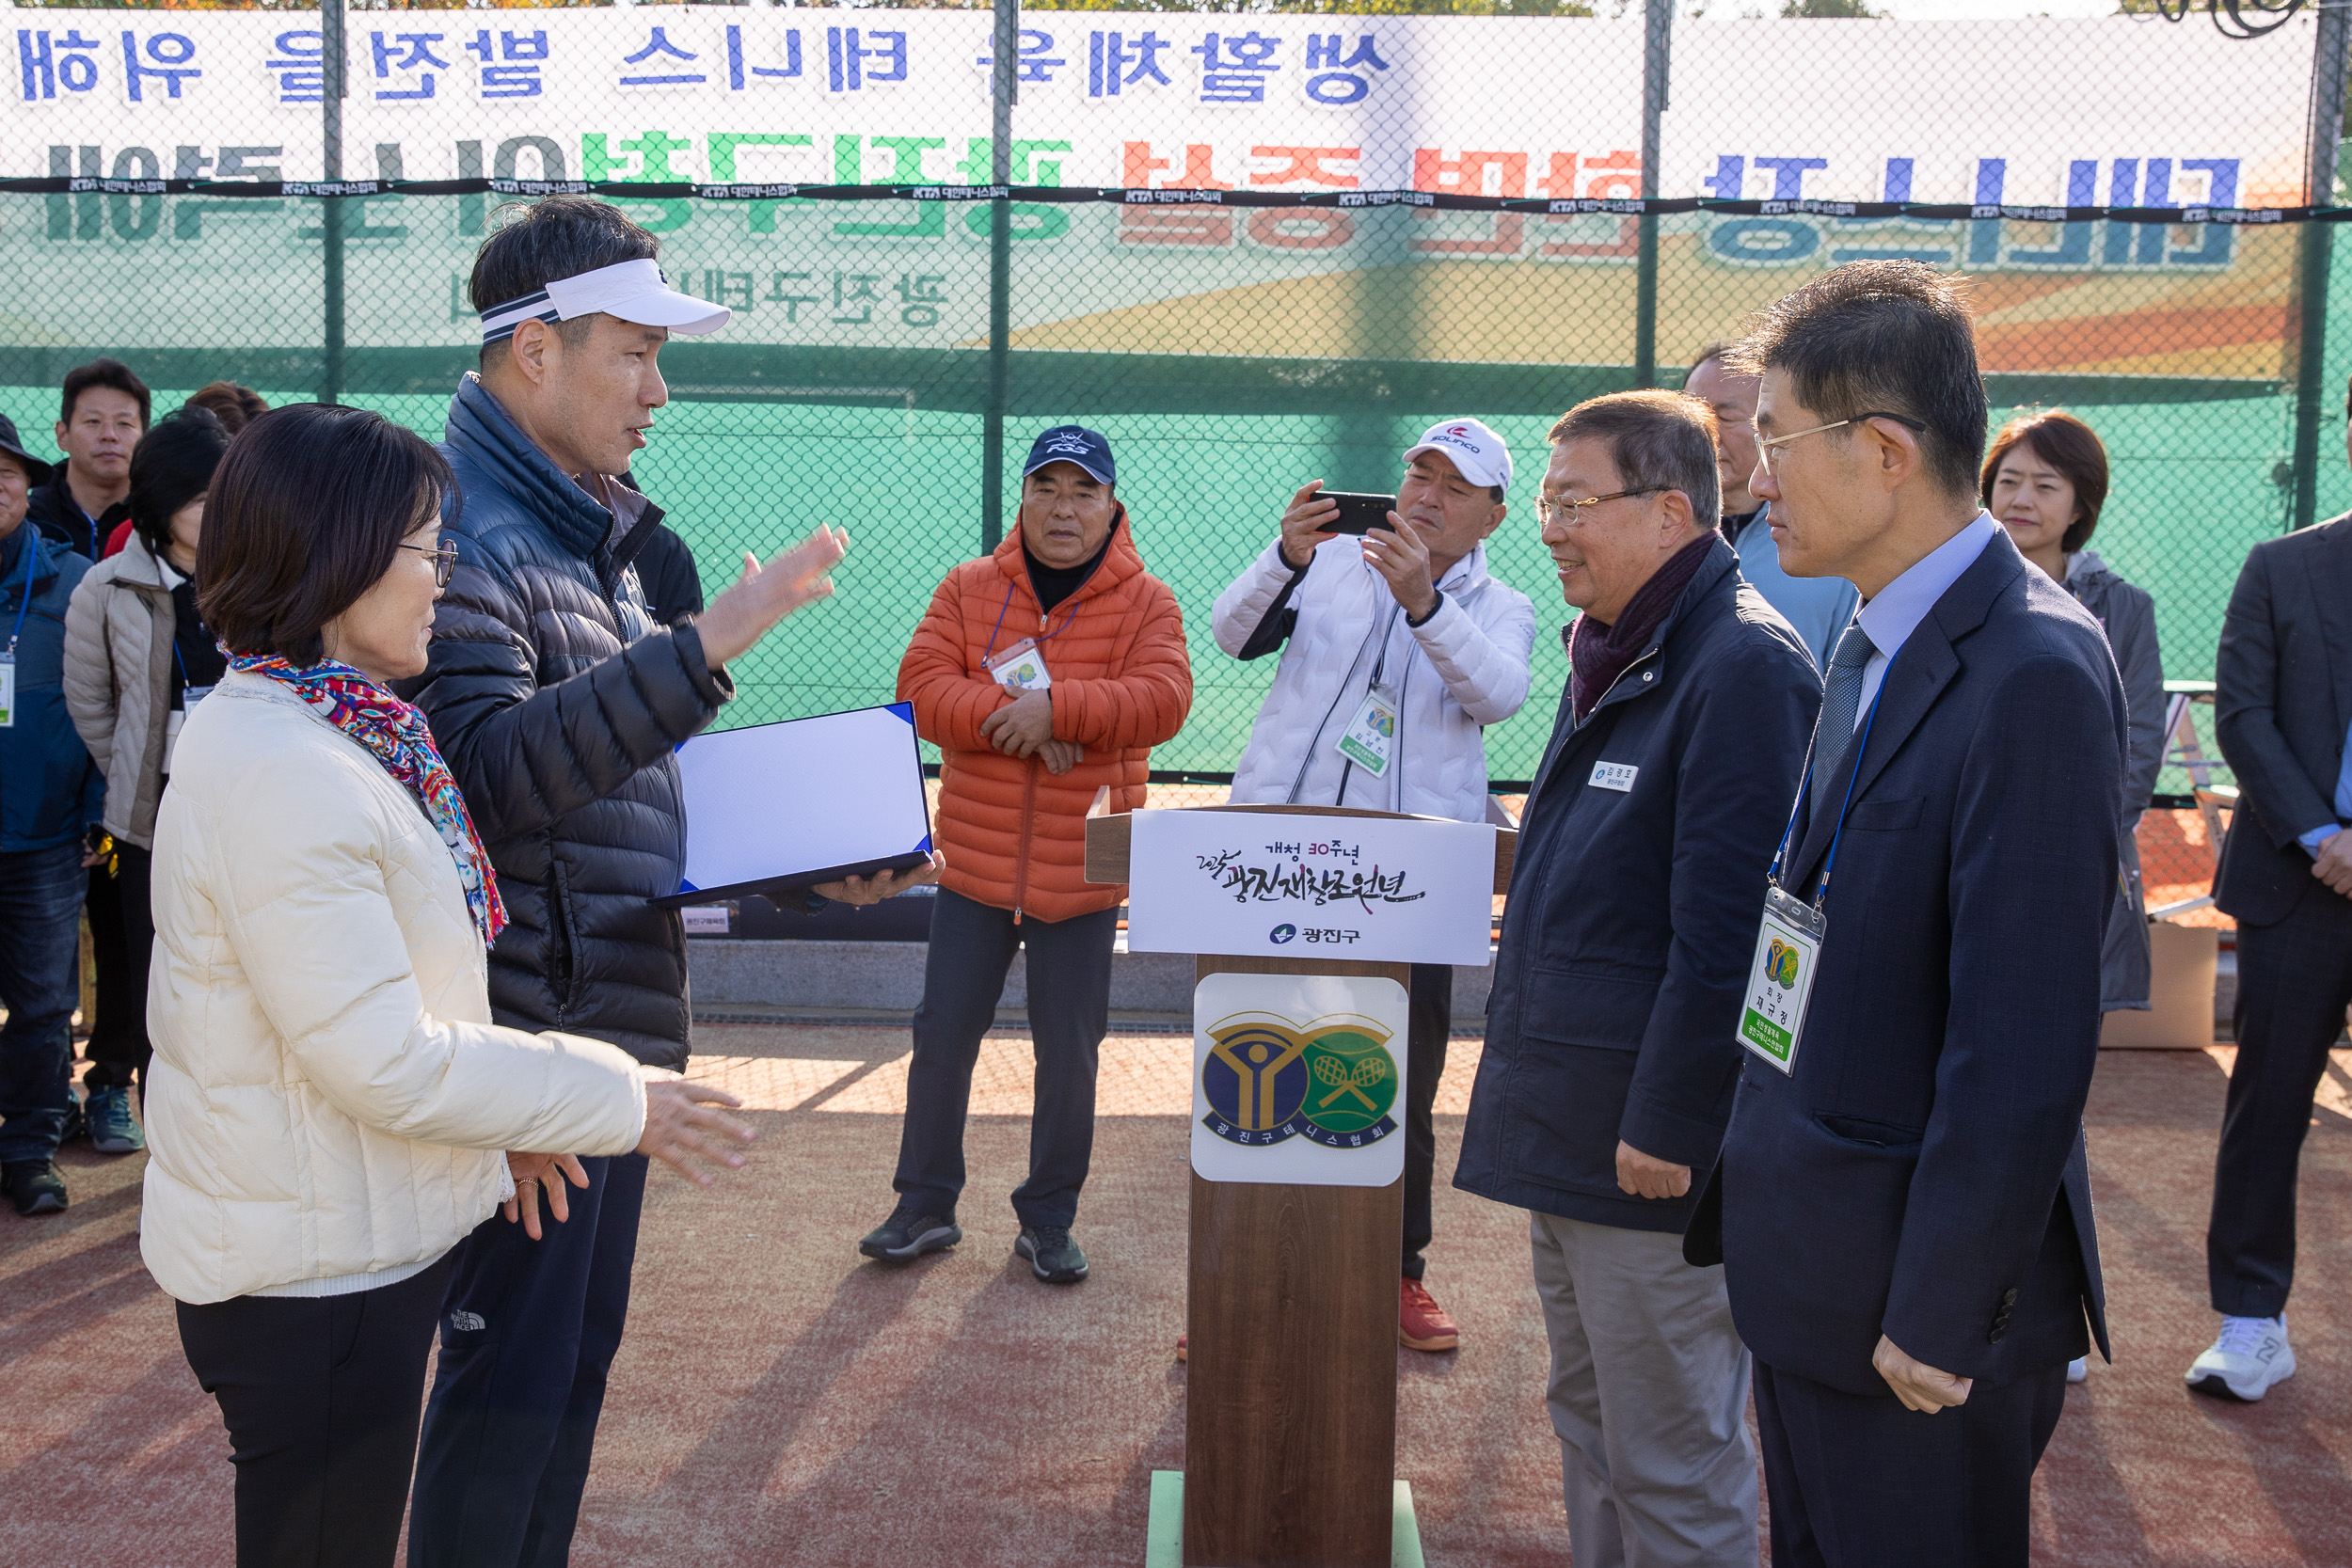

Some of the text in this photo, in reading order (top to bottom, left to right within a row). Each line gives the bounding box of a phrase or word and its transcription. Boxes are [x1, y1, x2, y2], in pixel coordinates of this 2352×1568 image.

[310, 182, 378, 196] 대한테니스협회
[520, 182, 587, 194] 대한테니스협회
[702, 185, 730, 198] KTA
[913, 186, 941, 198] KTA
[1125, 190, 1153, 202] KTA
[1339, 193, 1367, 206] KTA
[1429, 435, 1481, 454] SOLINCO
[1265, 839, 1359, 866] 개청 30주년
[1301, 927, 1361, 944] 광진구
[1216, 1123, 1385, 1147] 광진구테니스협회
[451, 1313, 469, 1325] NORTH
[456, 1308, 469, 1318] THE
[453, 1322, 470, 1332] FACE
